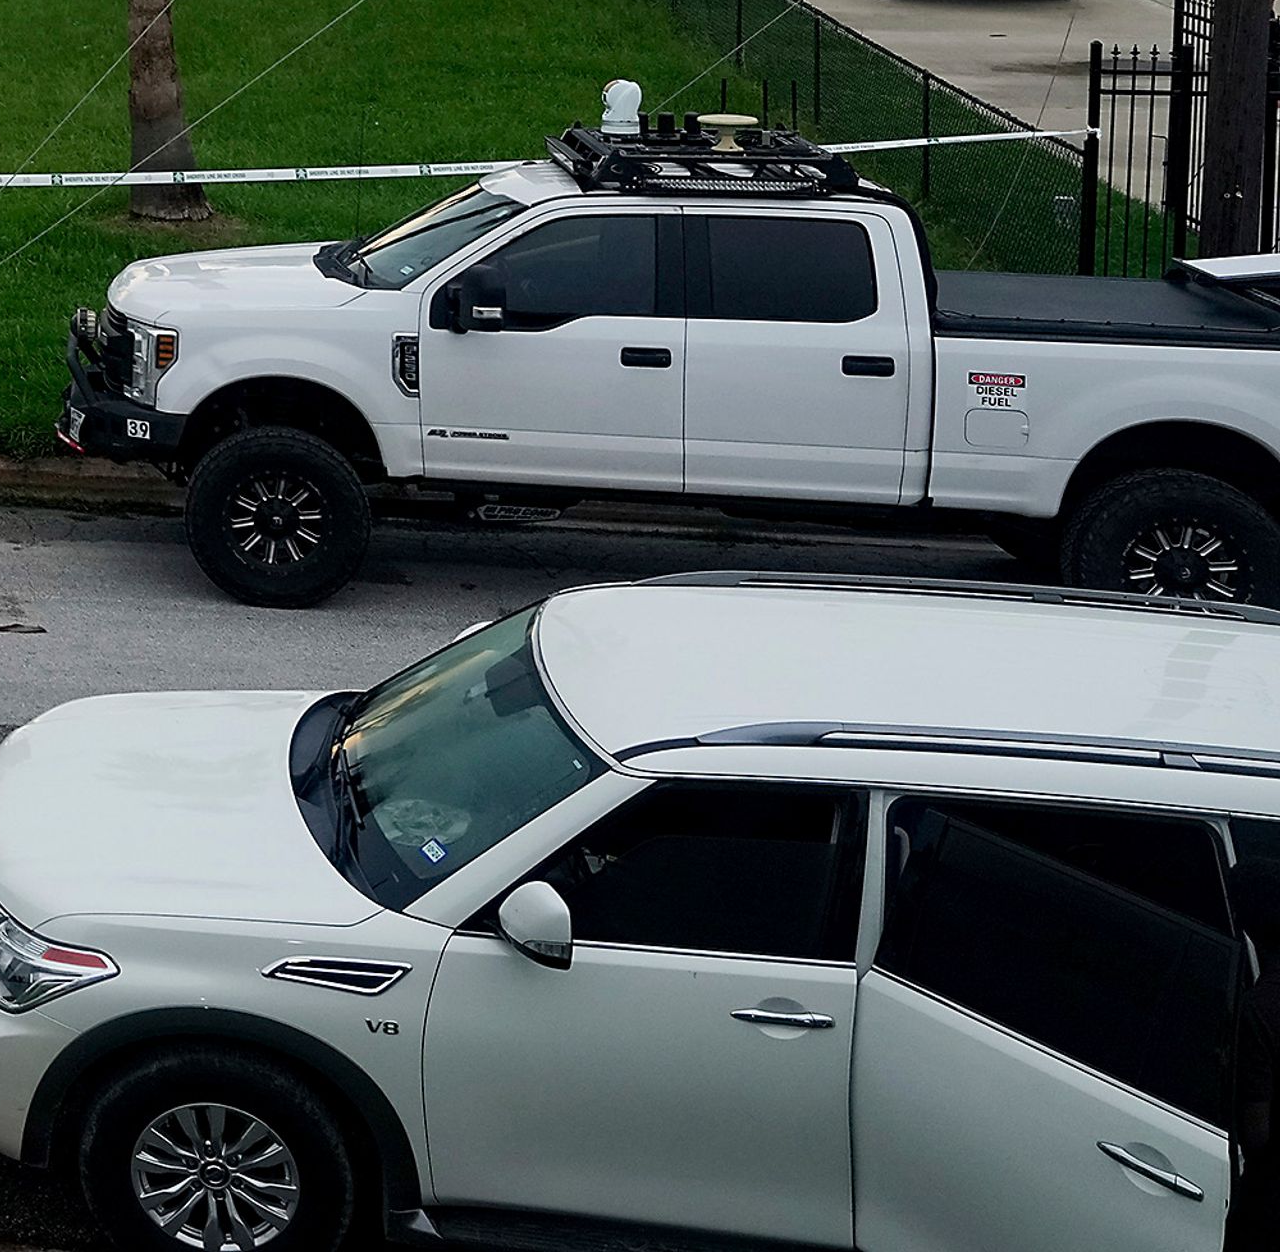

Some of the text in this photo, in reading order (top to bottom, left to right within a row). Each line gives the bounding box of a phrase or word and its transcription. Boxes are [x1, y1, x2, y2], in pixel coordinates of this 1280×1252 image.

[979, 375, 1015, 385] DANGER
[976, 386, 1017, 397] DIESEL
[981, 397, 1012, 407] FUEL
[129, 421, 149, 438] 39
[364, 1018, 400, 1036] V8
